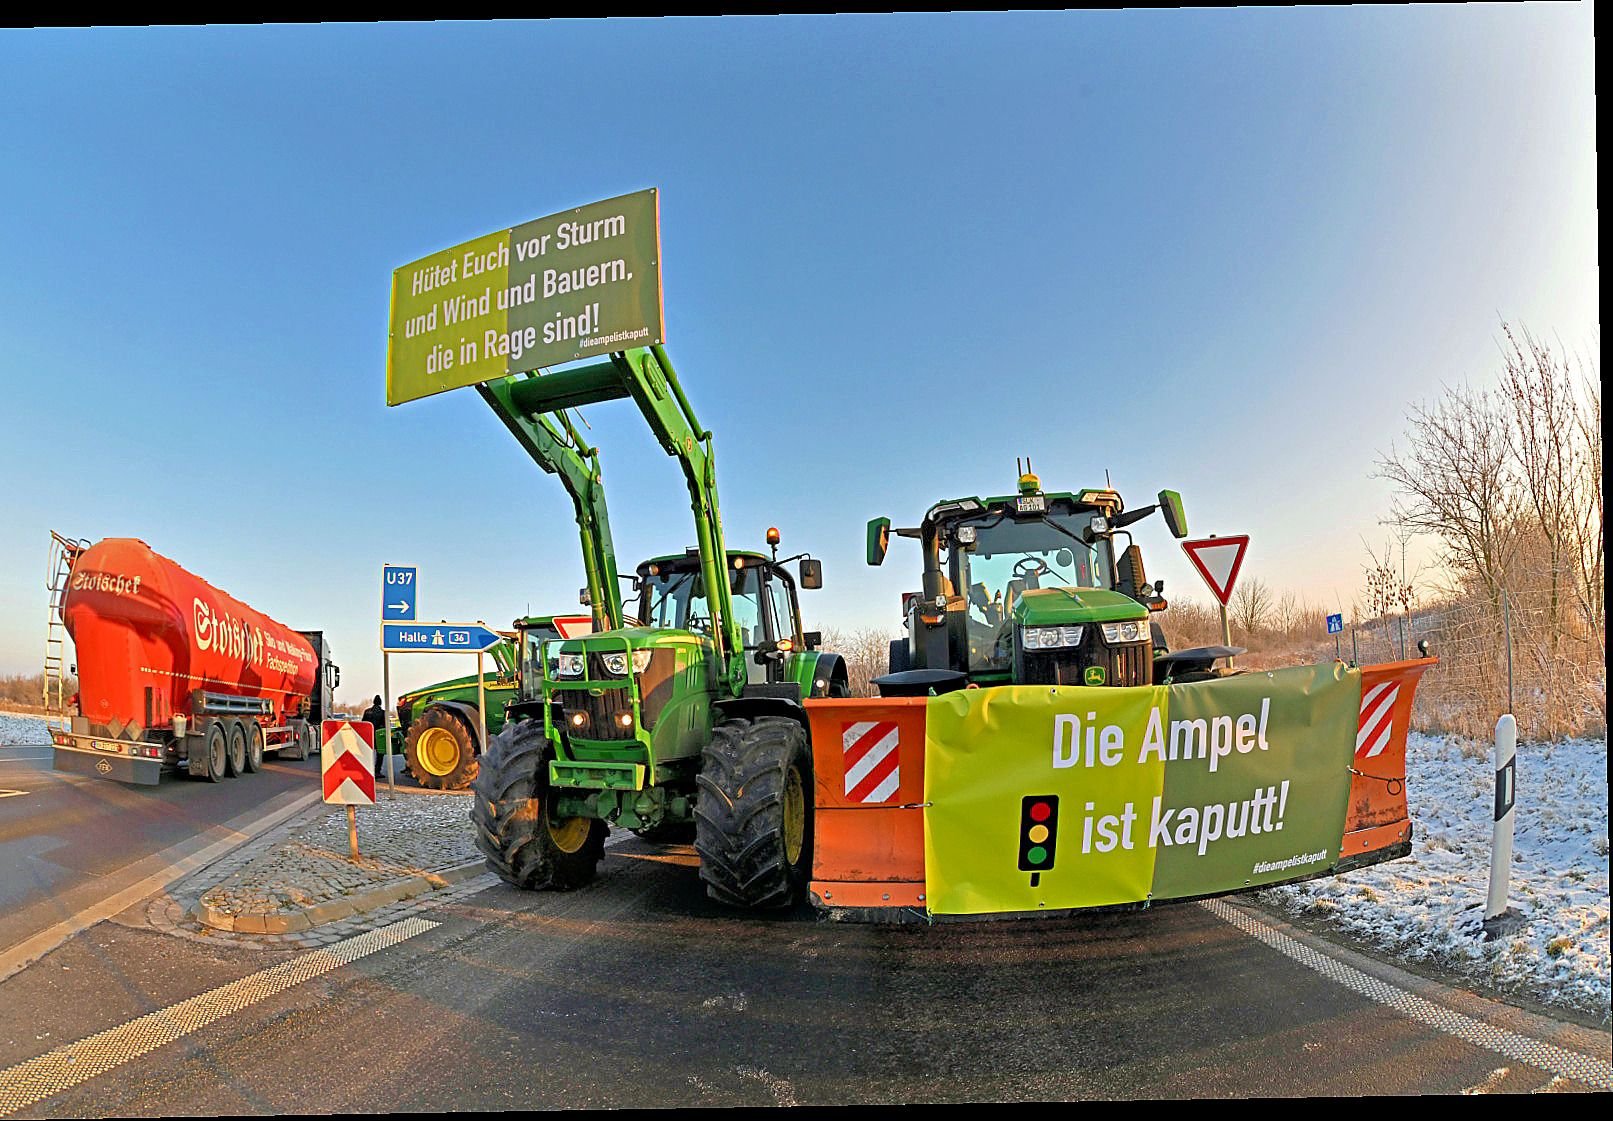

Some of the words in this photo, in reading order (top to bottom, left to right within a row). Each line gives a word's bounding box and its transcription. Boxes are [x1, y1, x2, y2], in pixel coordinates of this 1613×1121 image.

[411, 259, 458, 297] Hütet
[461, 241, 510, 280] Euch
[515, 233, 551, 262] vor
[556, 214, 625, 250] Sturm
[405, 303, 437, 338] und
[442, 288, 490, 326] Wind
[496, 274, 536, 311] und
[542, 258, 633, 298] Bauern,
[426, 344, 454, 375] die
[459, 337, 477, 366] in
[484, 328, 536, 361] Rage
[542, 302, 600, 344] sind!
[579, 327, 649, 348] #dieampelistkaputt
[400, 631, 428, 643] Halle
[454, 633, 465, 642] 36
[1051, 711, 1125, 769] Die
[1137, 697, 1271, 773] Ampel
[1081, 801, 1139, 854] ist
[1148, 780, 1291, 856] kaputt!
[1252, 848, 1328, 875] #dieampelistkaputt
